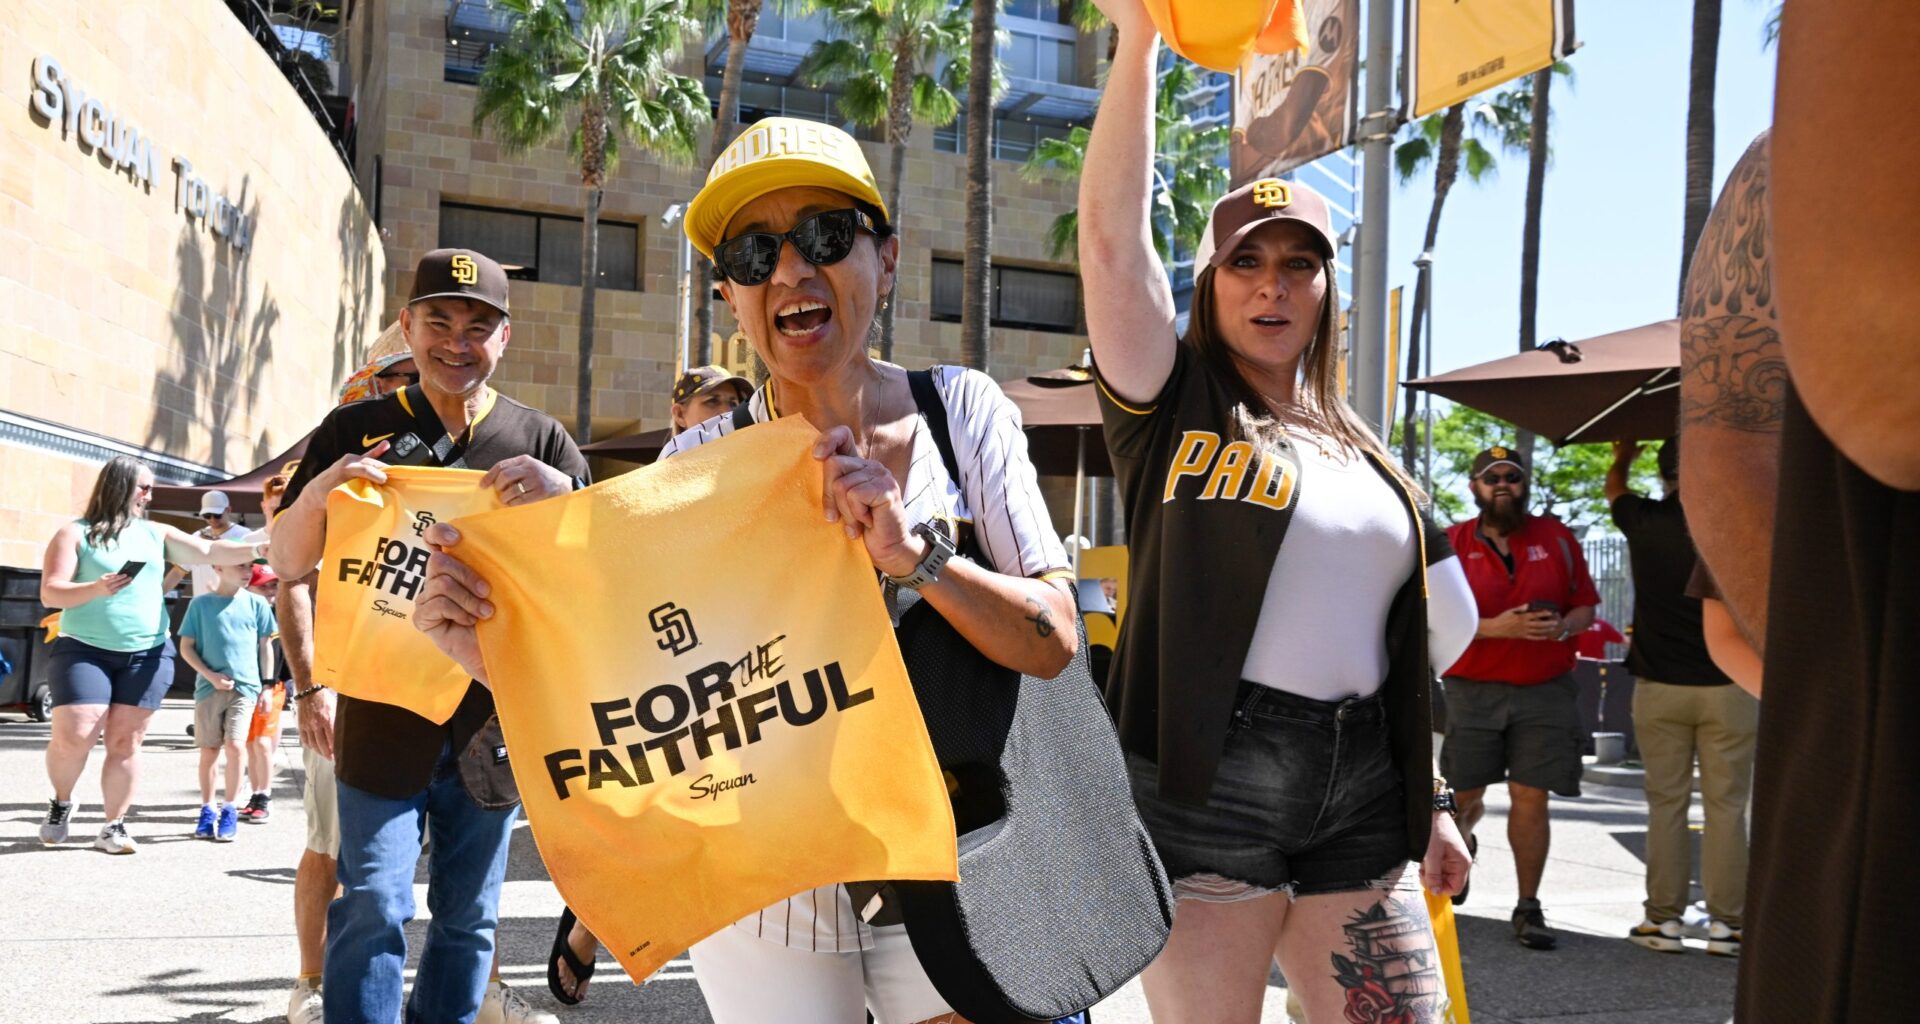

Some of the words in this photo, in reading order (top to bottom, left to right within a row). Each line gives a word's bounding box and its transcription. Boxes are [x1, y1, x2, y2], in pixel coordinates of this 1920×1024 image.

[32, 54, 161, 189] SYCUAN
[1253, 181, 1291, 207] SD
[452, 255, 478, 284] SD
[1163, 430, 1299, 511] PAD
[374, 537, 431, 577] FOR
[648, 602, 698, 657] SD
[590, 661, 736, 746] FOR
[730, 635, 786, 687] THE
[544, 661, 875, 800] FAITHFUL
[689, 773, 757, 801] Sycuan
